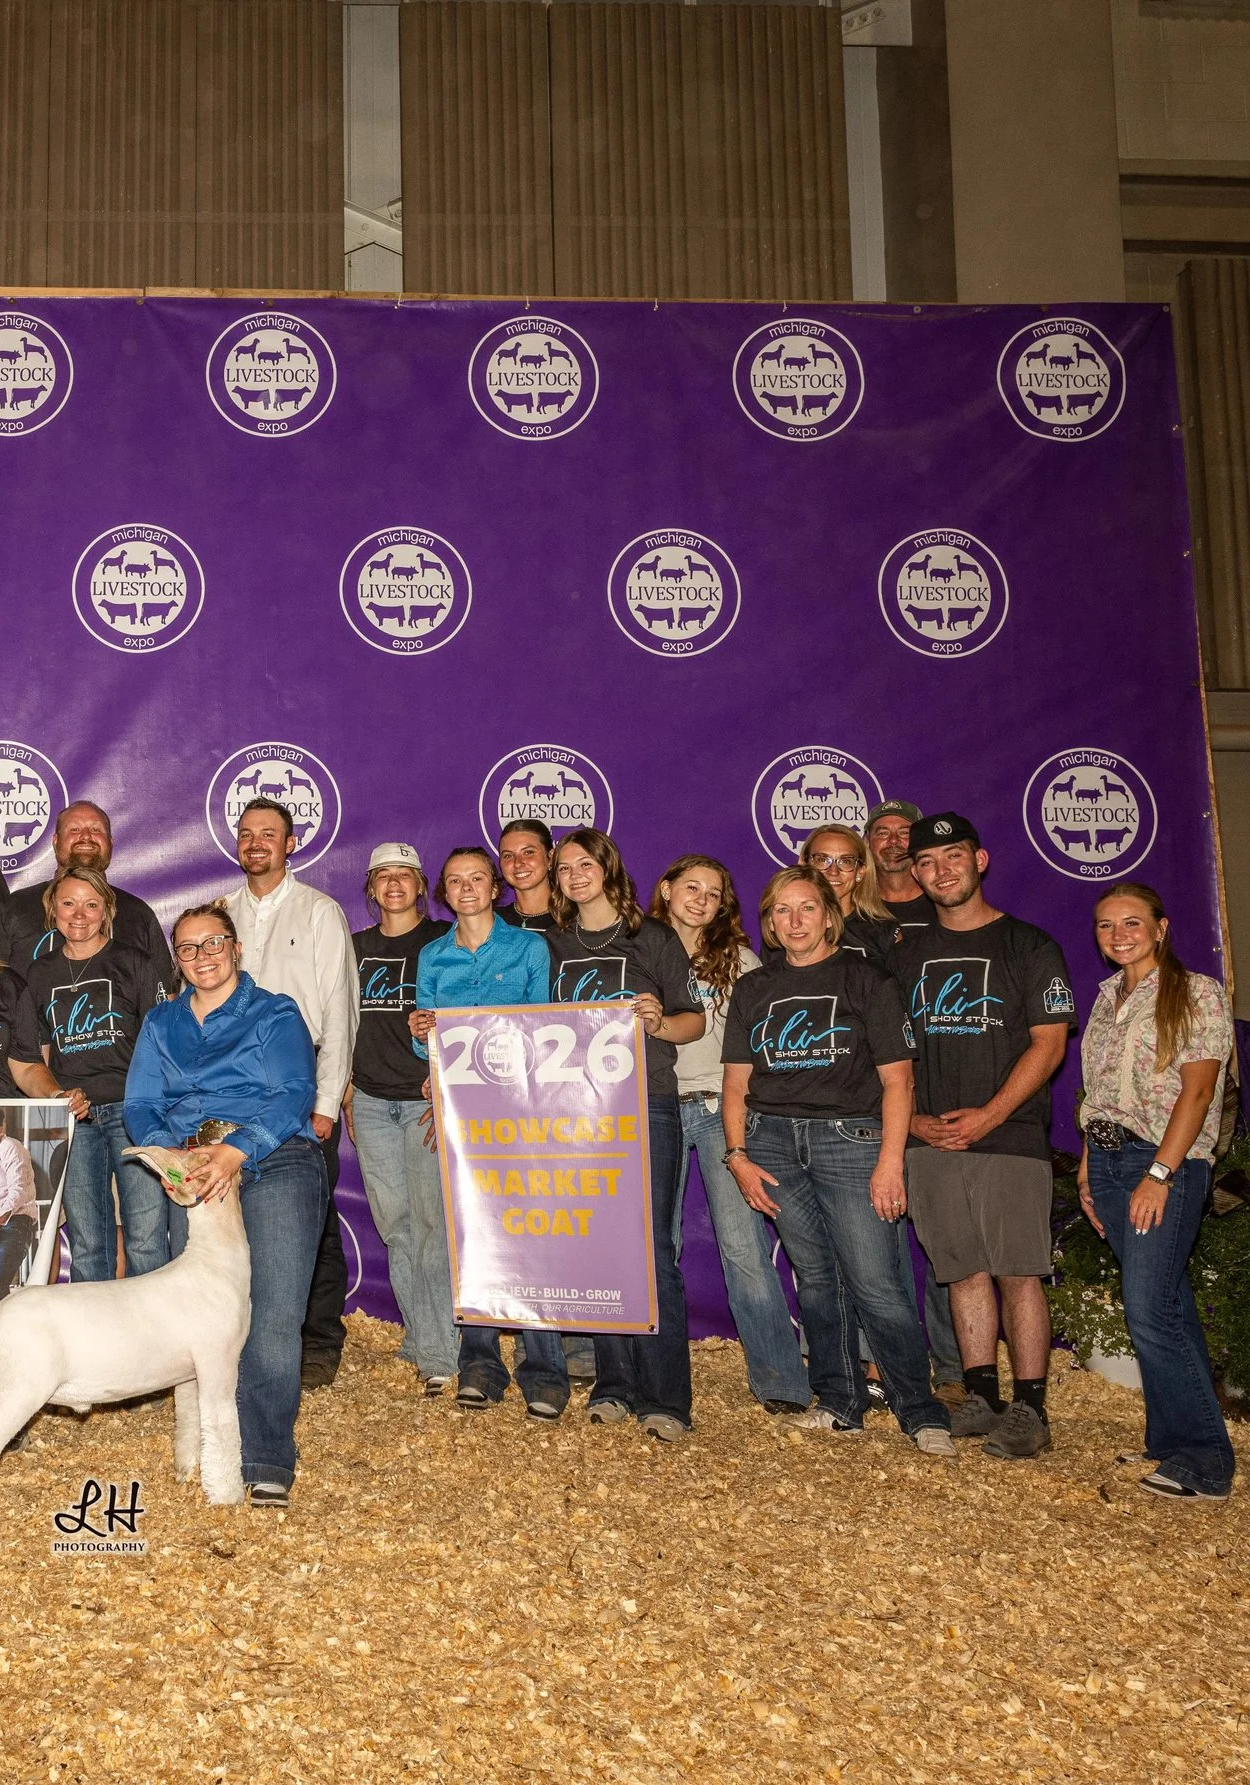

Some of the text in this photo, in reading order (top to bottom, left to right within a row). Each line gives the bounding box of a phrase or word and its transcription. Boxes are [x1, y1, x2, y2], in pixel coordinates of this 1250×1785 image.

[245, 317, 300, 332] michigan
[506, 320, 561, 335] michigan
[769, 322, 825, 337] michigan
[1032, 323, 1089, 337] michigan
[227, 369, 316, 382] LIVESTOCK
[489, 373, 578, 386] LIVESTOCK
[753, 374, 843, 388] LIVESTOCK
[1019, 374, 1108, 388] LIVESTOCK
[258, 422, 289, 434] expo
[521, 426, 552, 438] expo
[788, 427, 819, 439] expo
[1053, 427, 1084, 439] expo
[112, 527, 168, 544] michigan
[378, 532, 434, 546] michigan
[645, 534, 702, 548] michigan
[914, 534, 970, 548] michigan
[93, 582, 183, 596] LIVESTOCK
[360, 584, 451, 598] LIVESTOCK
[629, 586, 719, 600] LIVESTOCK
[900, 586, 988, 601] LIVESTOCK
[124, 638, 155, 650] expo
[392, 640, 423, 652] expo
[662, 642, 693, 654] expo
[932, 642, 963, 654] expo
[246, 746, 303, 762] michigan
[517, 748, 575, 764] michigan
[789, 750, 846, 766] michigan
[1060, 752, 1117, 768] michigan
[227, 802, 320, 817] LIOCK
[501, 804, 592, 818] LIVESTOCK
[774, 806, 865, 820] LIVESTOCK
[1044, 808, 1136, 822] LIVESTOCK
[1080, 865, 1111, 877] expo
[965, 1016, 1004, 1026] STOCK
[64, 1032, 94, 1043] SHOW
[775, 1047, 851, 1058] SHOW STOCK
[458, 1114, 638, 1145] SHOWCASE
[473, 1168, 622, 1197] MARKET
[503, 1208, 593, 1236] GOAT
[543, 1288, 579, 1299] BUILD
[586, 1290, 621, 1300] GROW
[542, 1303, 561, 1312] OUR
[563, 1305, 625, 1315] AGRICULTURE
